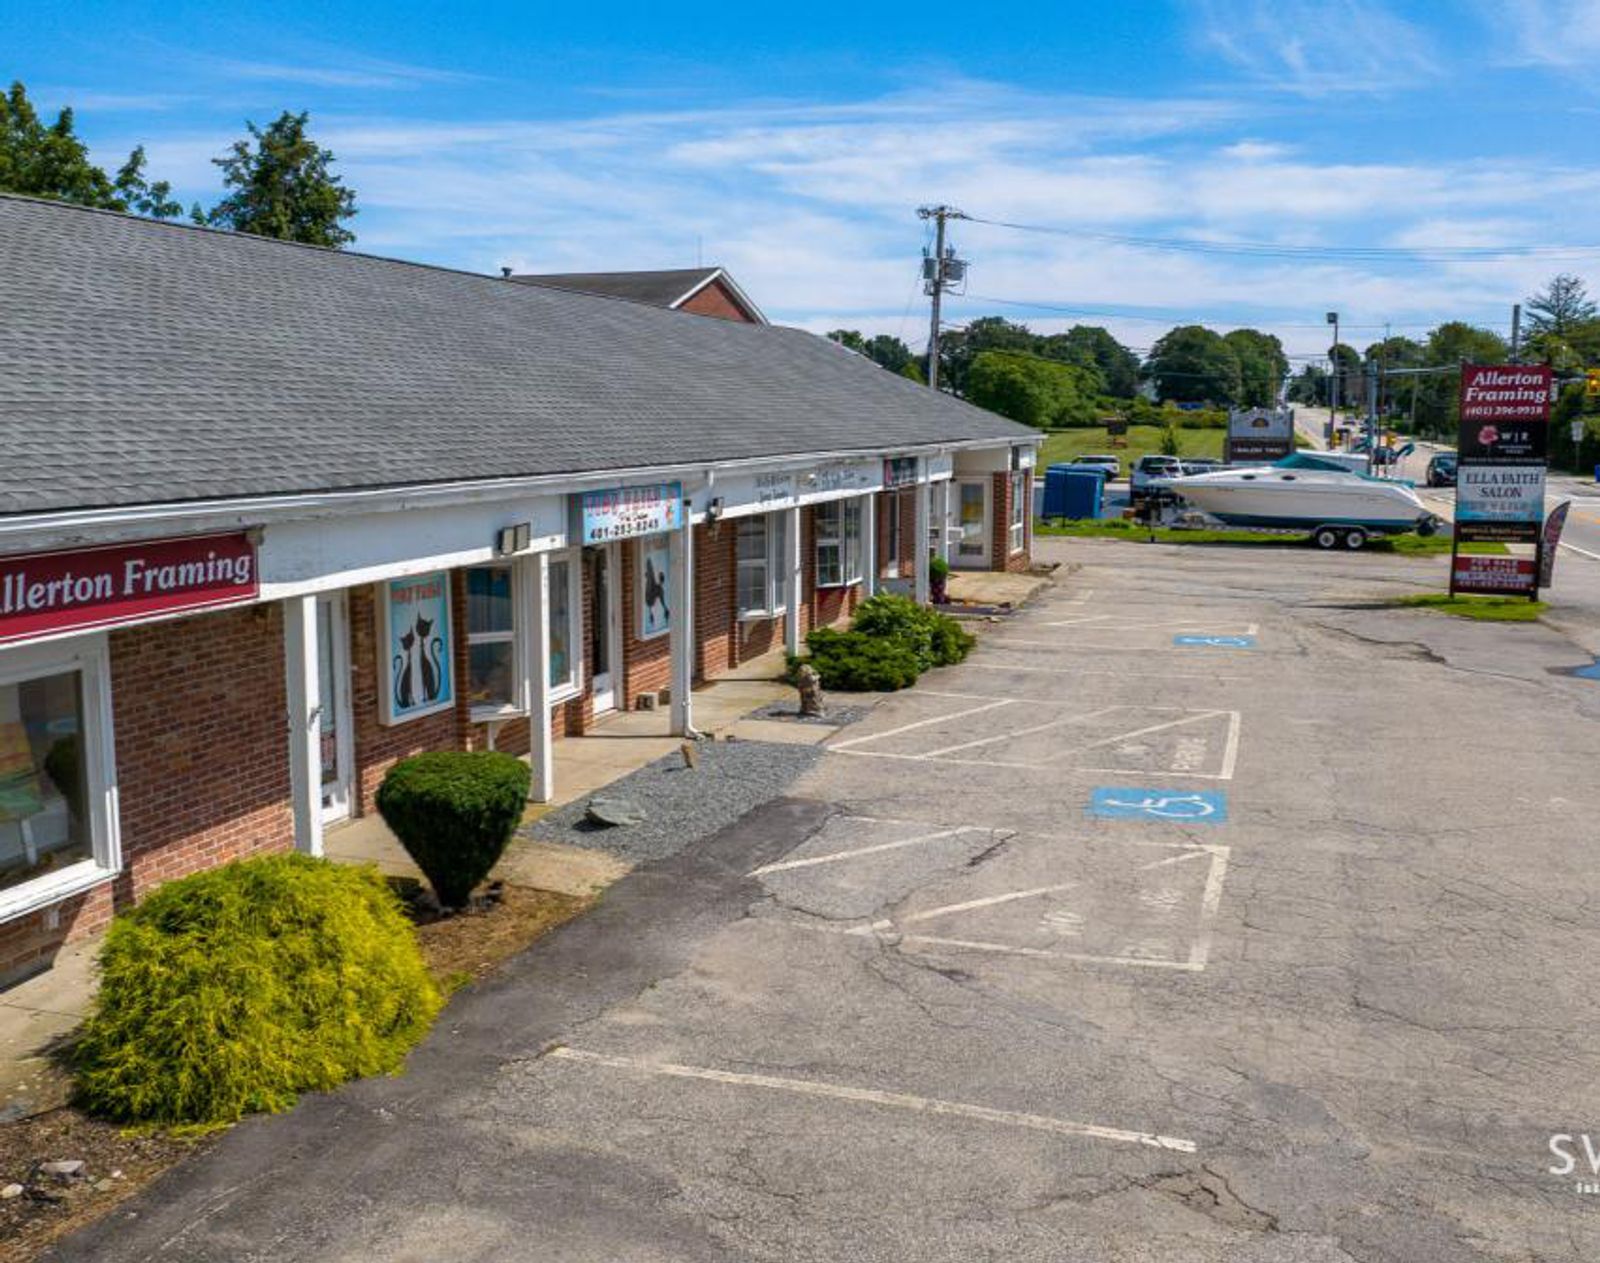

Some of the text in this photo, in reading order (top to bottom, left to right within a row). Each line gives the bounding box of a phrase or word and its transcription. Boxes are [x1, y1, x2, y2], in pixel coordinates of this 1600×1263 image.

[1472, 370, 1543, 386] Allerton
[1464, 386, 1547, 403] Framing
[1466, 472, 1540, 485] ELLA FAITH
[1480, 486, 1523, 498] SALON
[0, 550, 251, 613] llerton Framing
